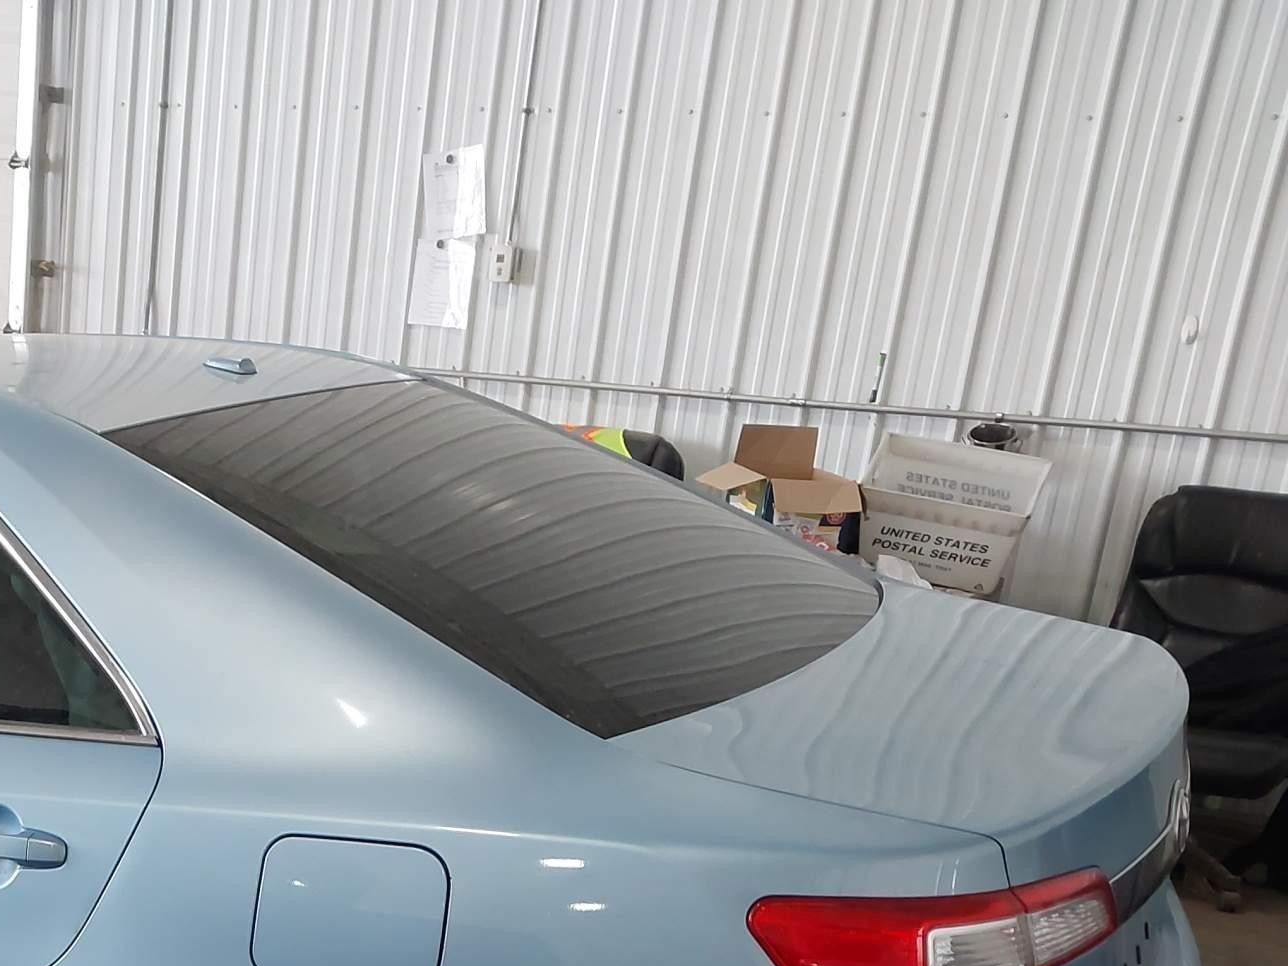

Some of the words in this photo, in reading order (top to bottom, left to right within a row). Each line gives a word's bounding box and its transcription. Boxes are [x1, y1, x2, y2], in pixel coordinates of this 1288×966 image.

[872, 538, 926, 556] POSTAL
[929, 549, 992, 568] SERVICE
[880, 526, 932, 543] UNITED
[933, 536, 990, 554] STATES
